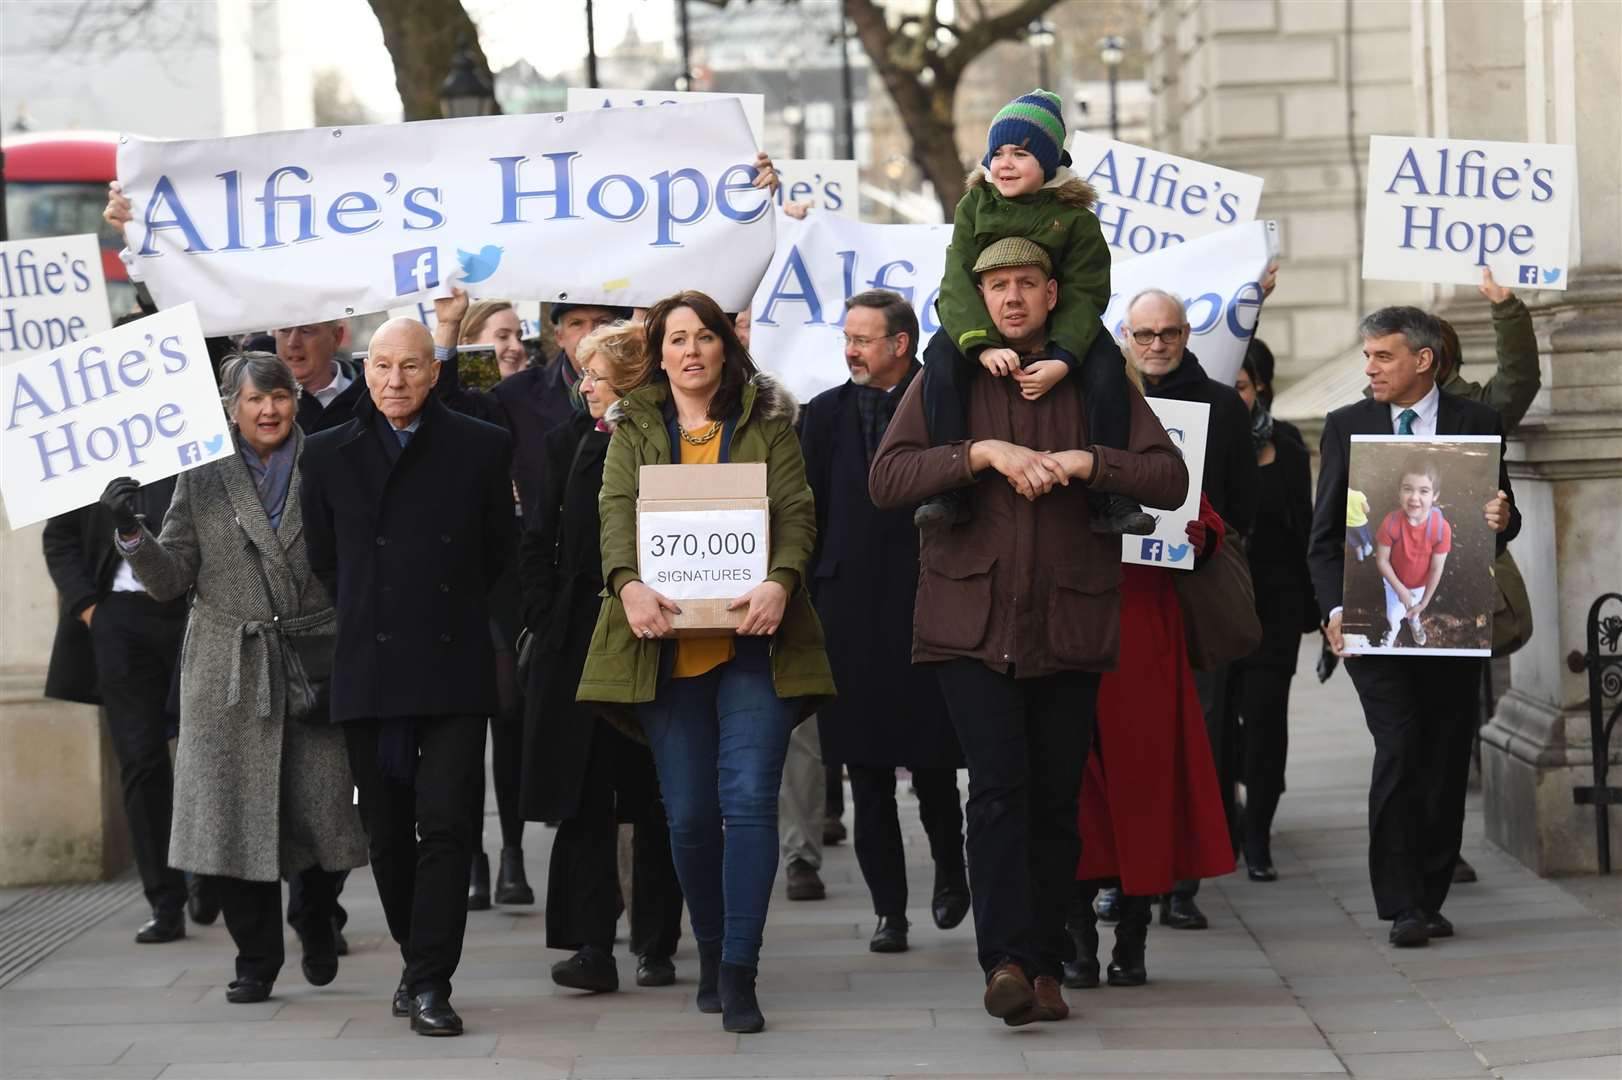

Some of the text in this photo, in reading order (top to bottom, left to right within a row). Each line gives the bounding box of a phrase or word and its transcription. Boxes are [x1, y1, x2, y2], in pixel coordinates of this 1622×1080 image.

[138, 151, 771, 257] Alfie's Hope
[1086, 149, 1241, 224] Alfie's
[1384, 147, 1554, 202] Alfie's
[1398, 205, 1536, 266] Hope
[6, 333, 191, 431] Alfie's
[28, 402, 187, 482] Hope
[650, 533, 756, 560] 370,000
[657, 568, 752, 583] SIGNATURES
